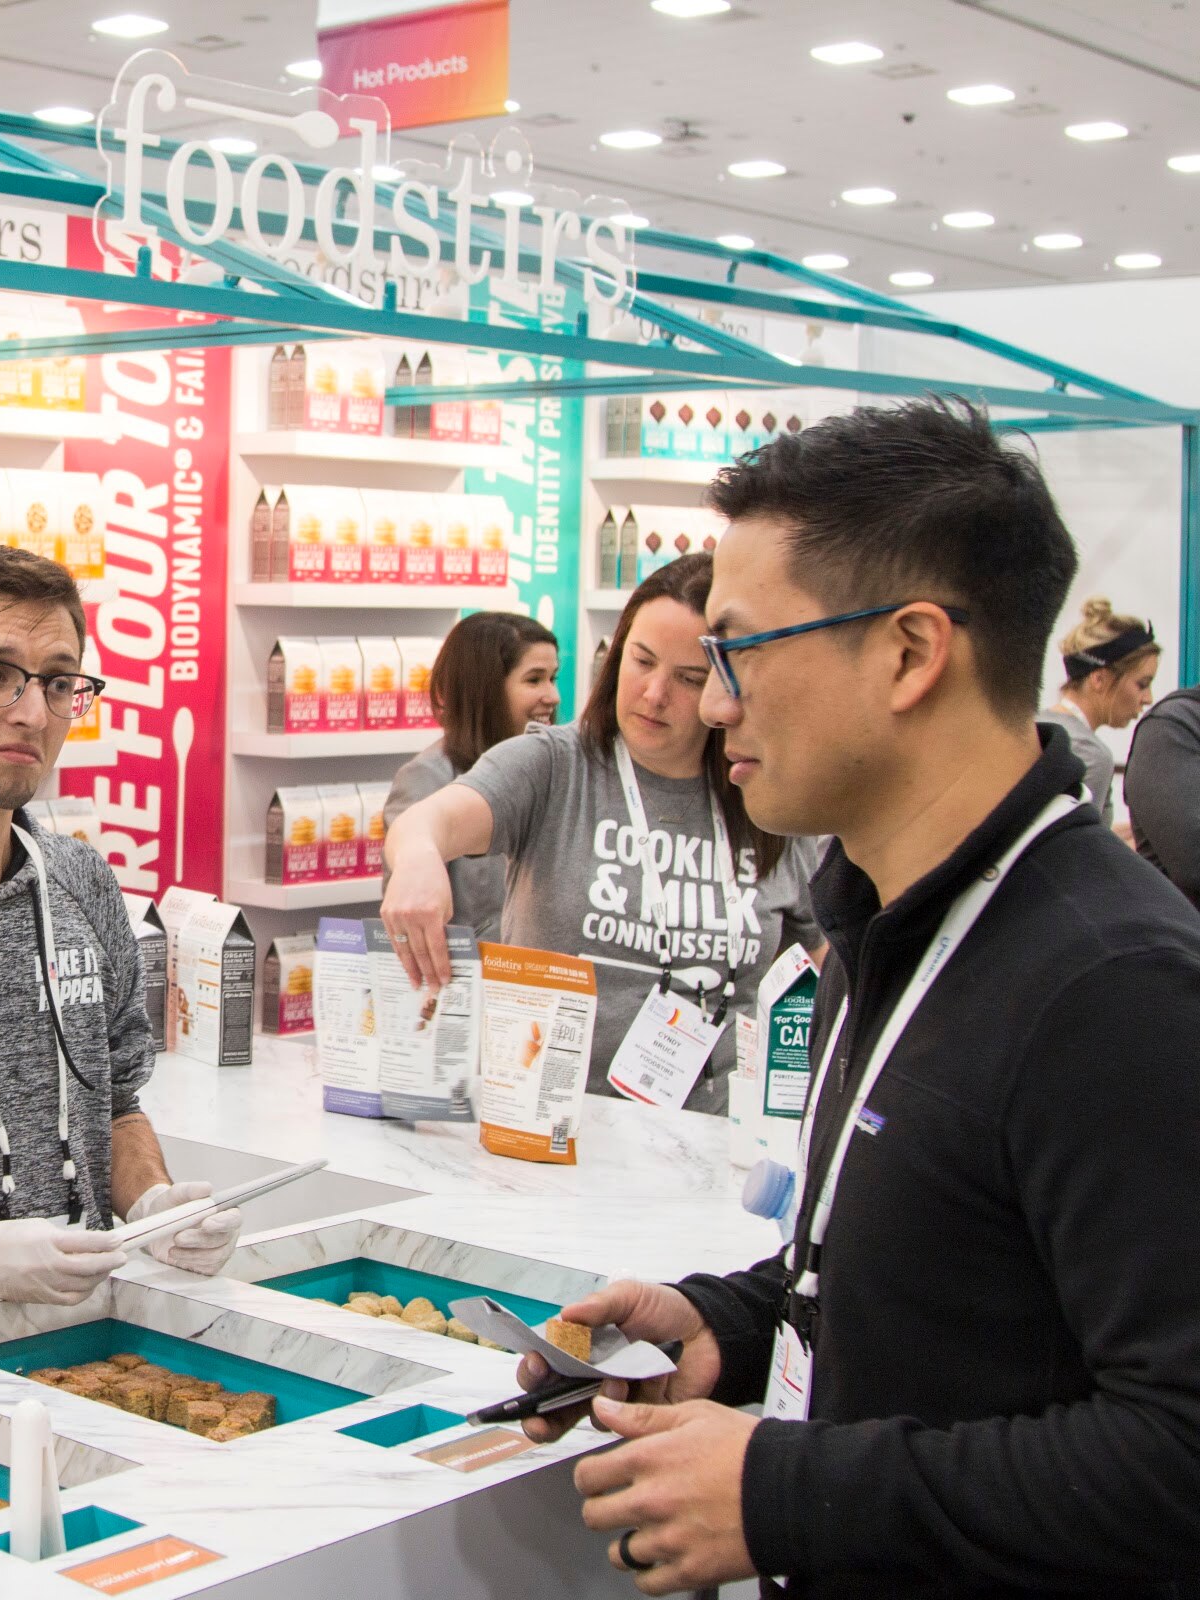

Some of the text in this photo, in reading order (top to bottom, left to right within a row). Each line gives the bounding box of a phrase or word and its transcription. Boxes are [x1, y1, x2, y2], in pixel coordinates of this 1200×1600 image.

[353, 55, 469, 89] Hot Products
[113, 73, 628, 307] foodstirs
[174, 416, 205, 441] &
[535, 446, 561, 574] IDENTITY
[95, 469, 171, 760] FLOUR
[588, 863, 762, 935] & MILK
[223, 951, 255, 959] ORGANIC
[483, 955, 522, 971] foodstirs
[774, 1014, 812, 1025] For Goo
[657, 1031, 682, 1048] CYNDY
[779, 1025, 811, 1047] CA
[652, 1040, 677, 1057] BRUCE
[640, 1054, 674, 1077] FOODSTIRS
